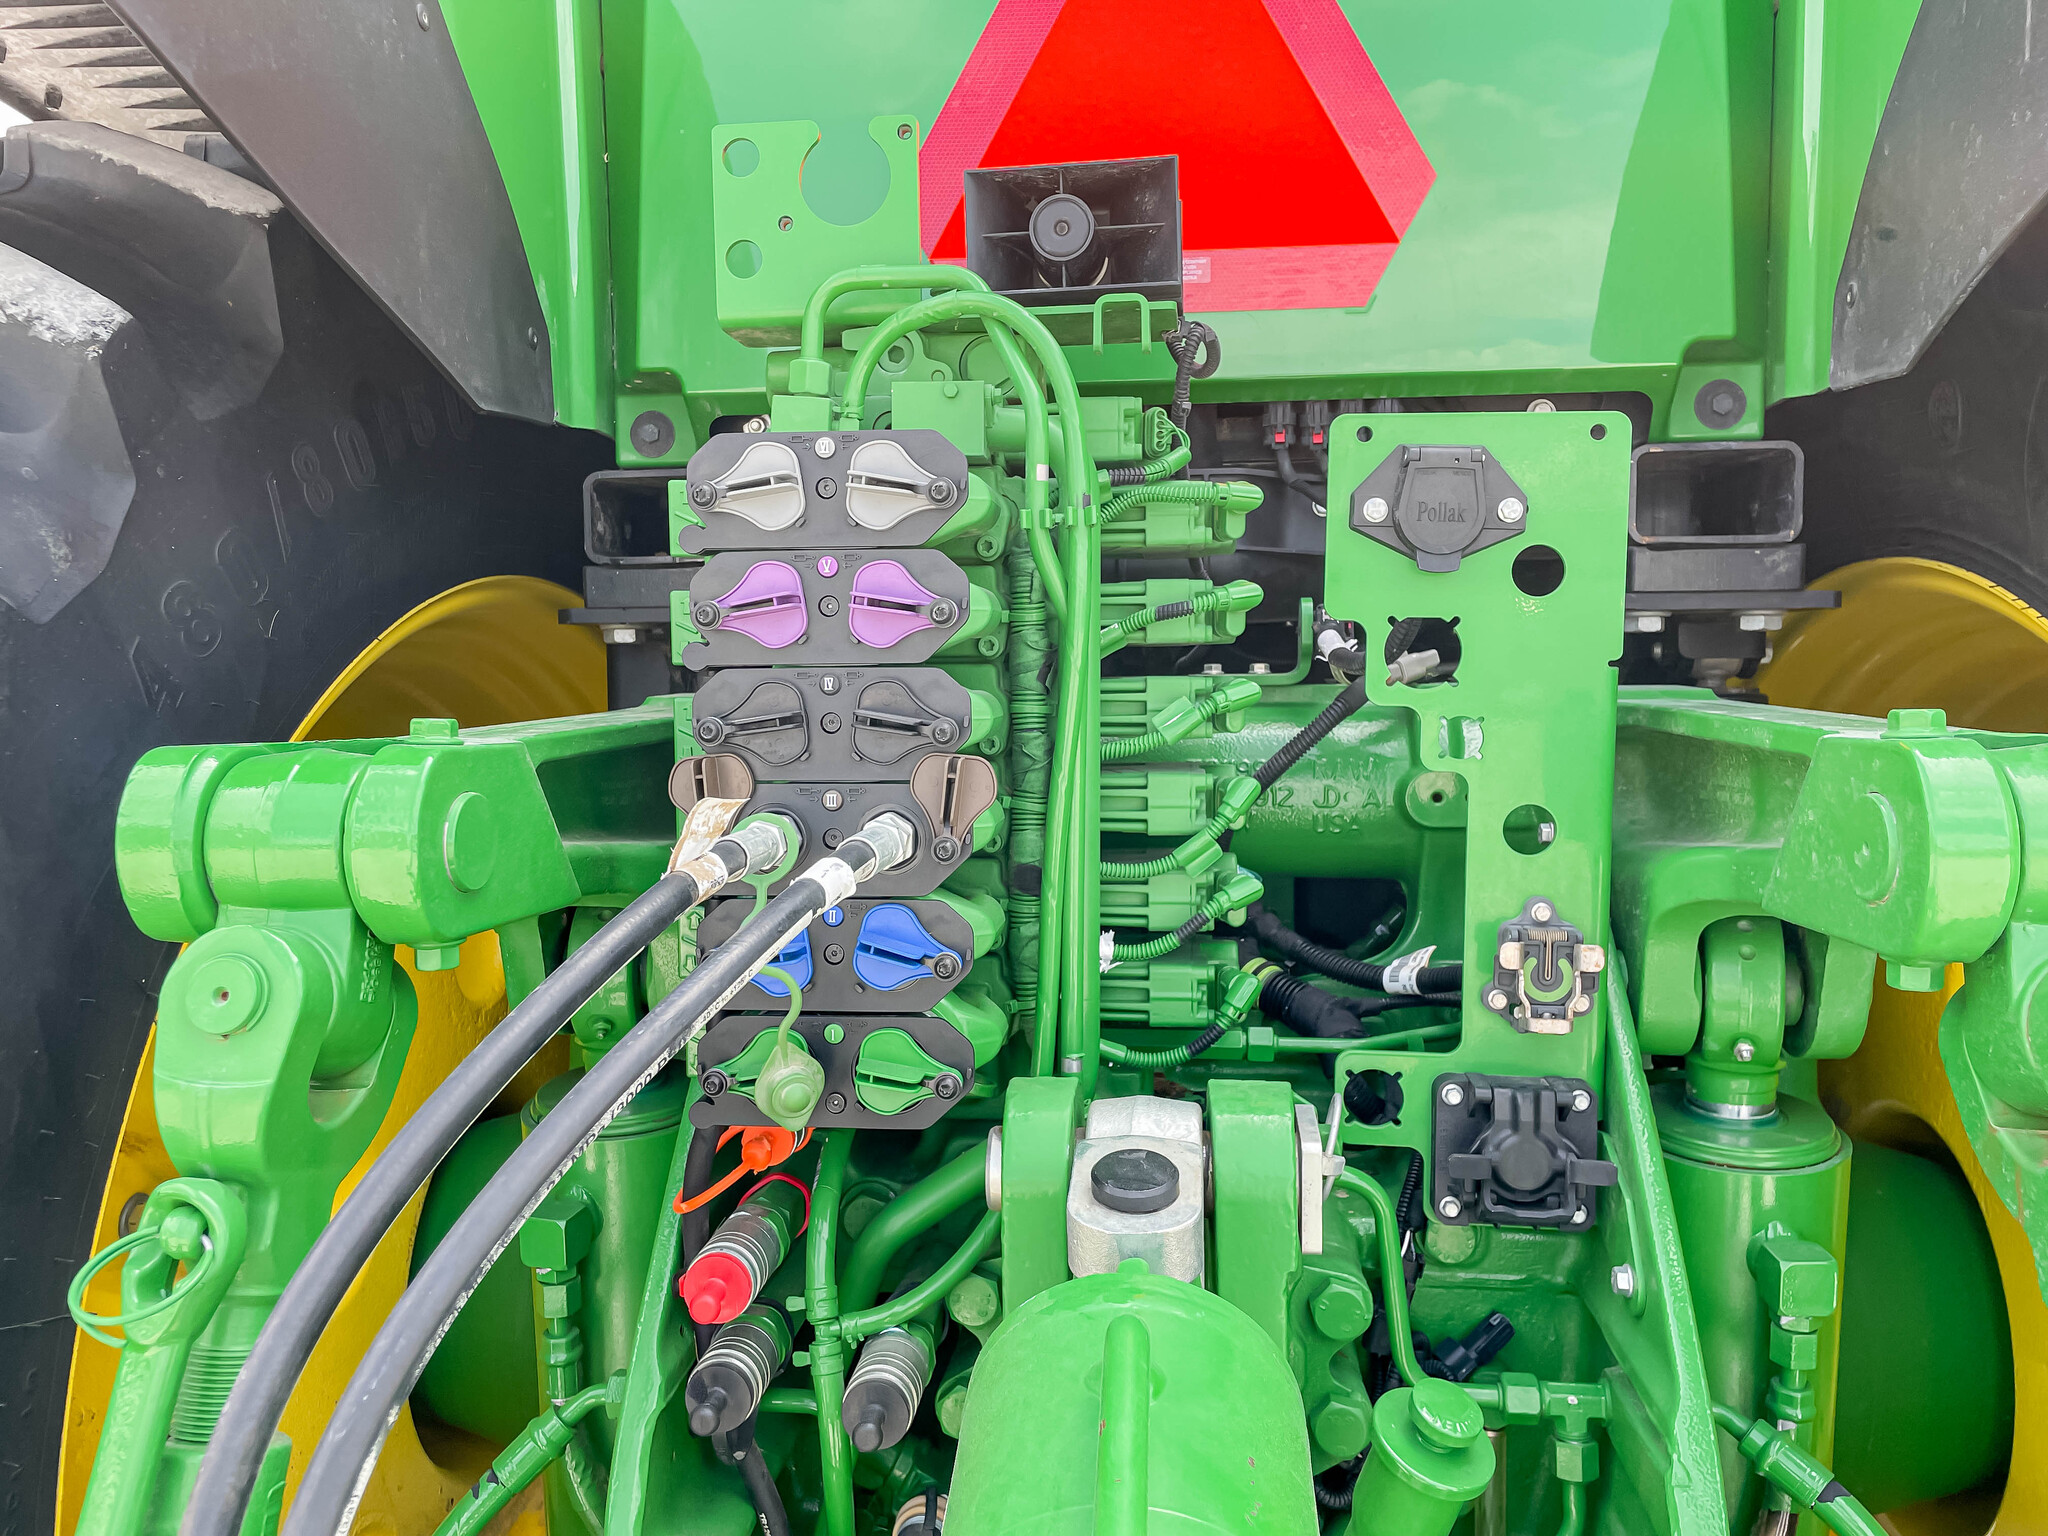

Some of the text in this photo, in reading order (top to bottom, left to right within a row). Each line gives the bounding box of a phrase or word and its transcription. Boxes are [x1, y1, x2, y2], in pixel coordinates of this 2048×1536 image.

[819, 441, 830, 453] VI
[1416, 501, 1468, 523] Pollak
[821, 559, 832, 573] V
[824, 677, 834, 690] IV
[826, 794, 837, 807] III
[1312, 813, 1361, 834] USA
[828, 910, 837, 923] II
